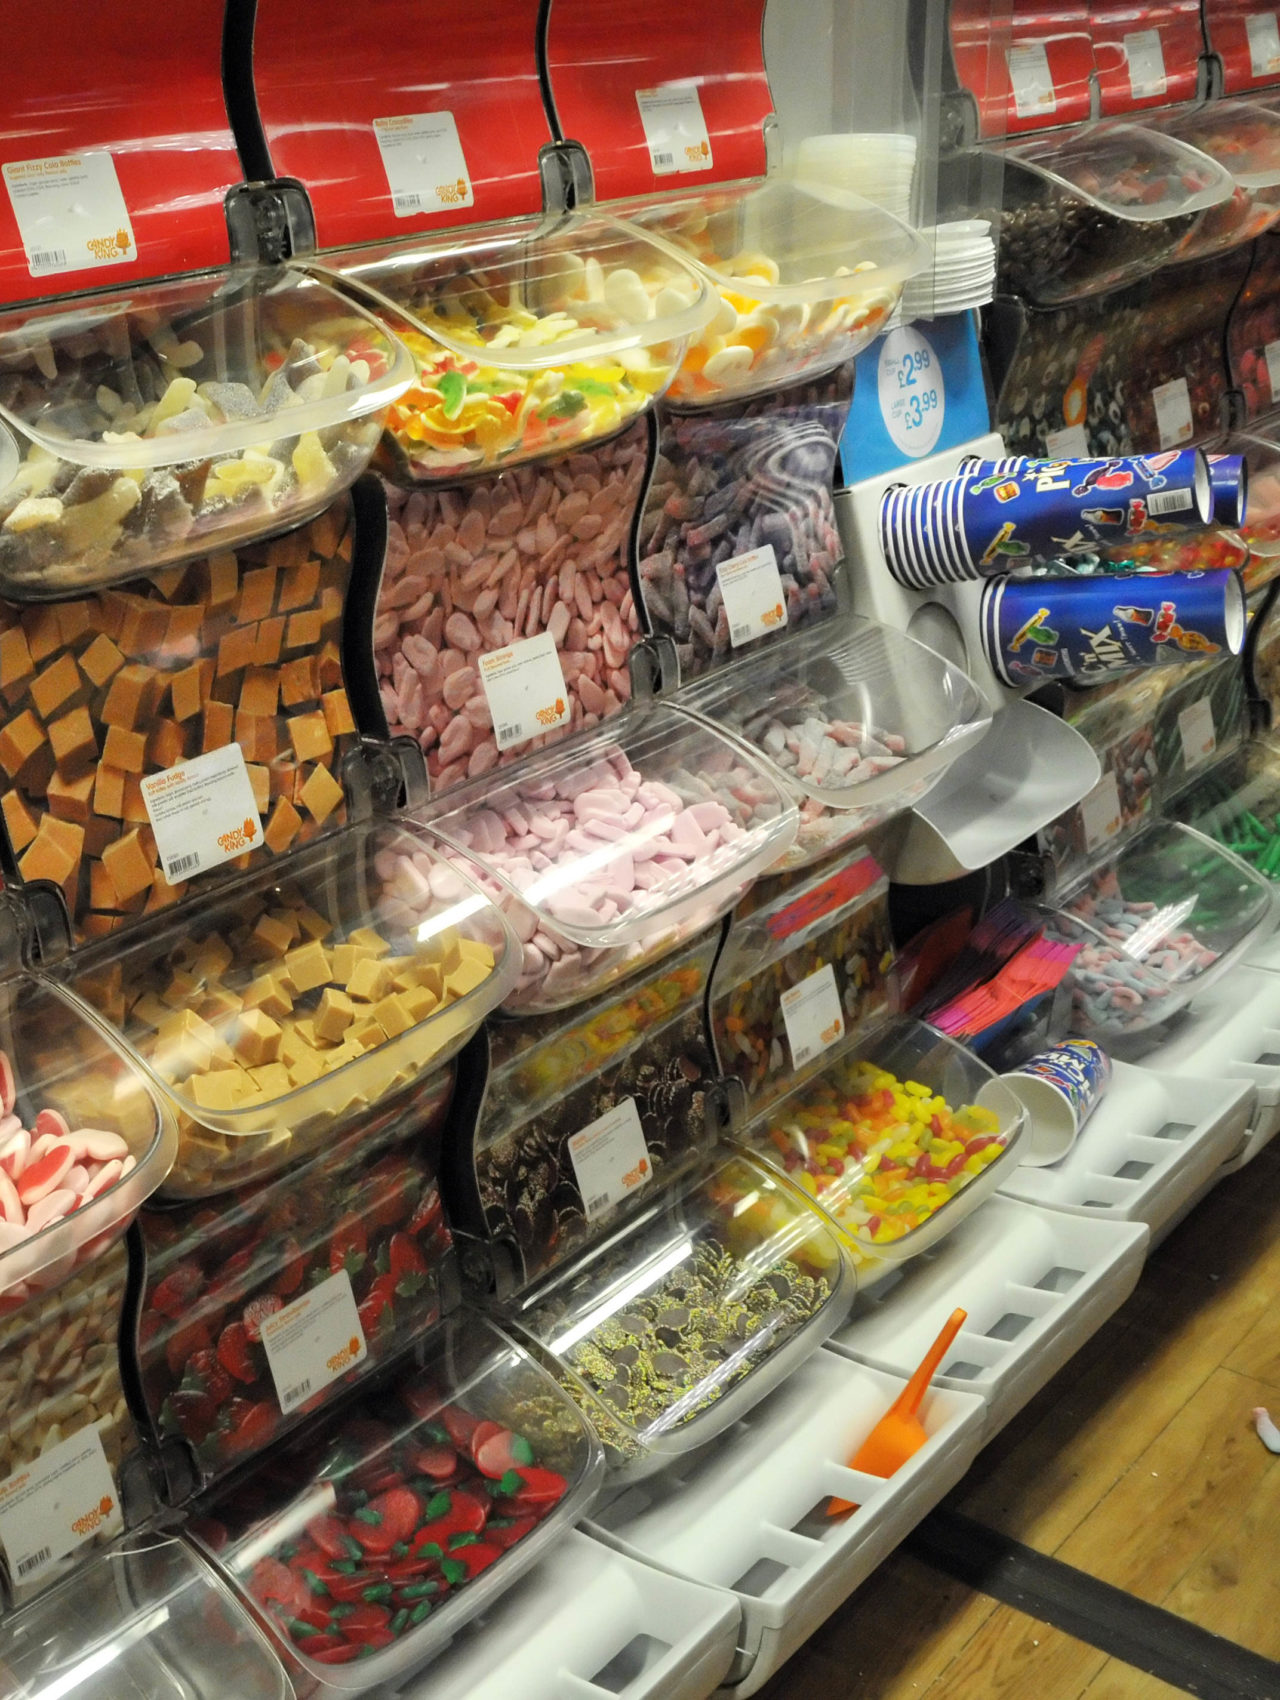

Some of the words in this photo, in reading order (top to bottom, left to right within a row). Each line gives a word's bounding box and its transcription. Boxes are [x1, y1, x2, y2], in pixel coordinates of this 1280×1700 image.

[87, 237, 115, 251] CANDY
[94, 247, 118, 260] KING
[897, 349, 930, 388] £2.99
[905, 389, 938, 430] £3.99
[166, 770, 185, 784] Fudge
[217, 827, 242, 847] CANDY
[224, 837, 246, 852] KING
[71, 1506, 99, 1532] CANDY
[79, 1517, 101, 1536] KING
